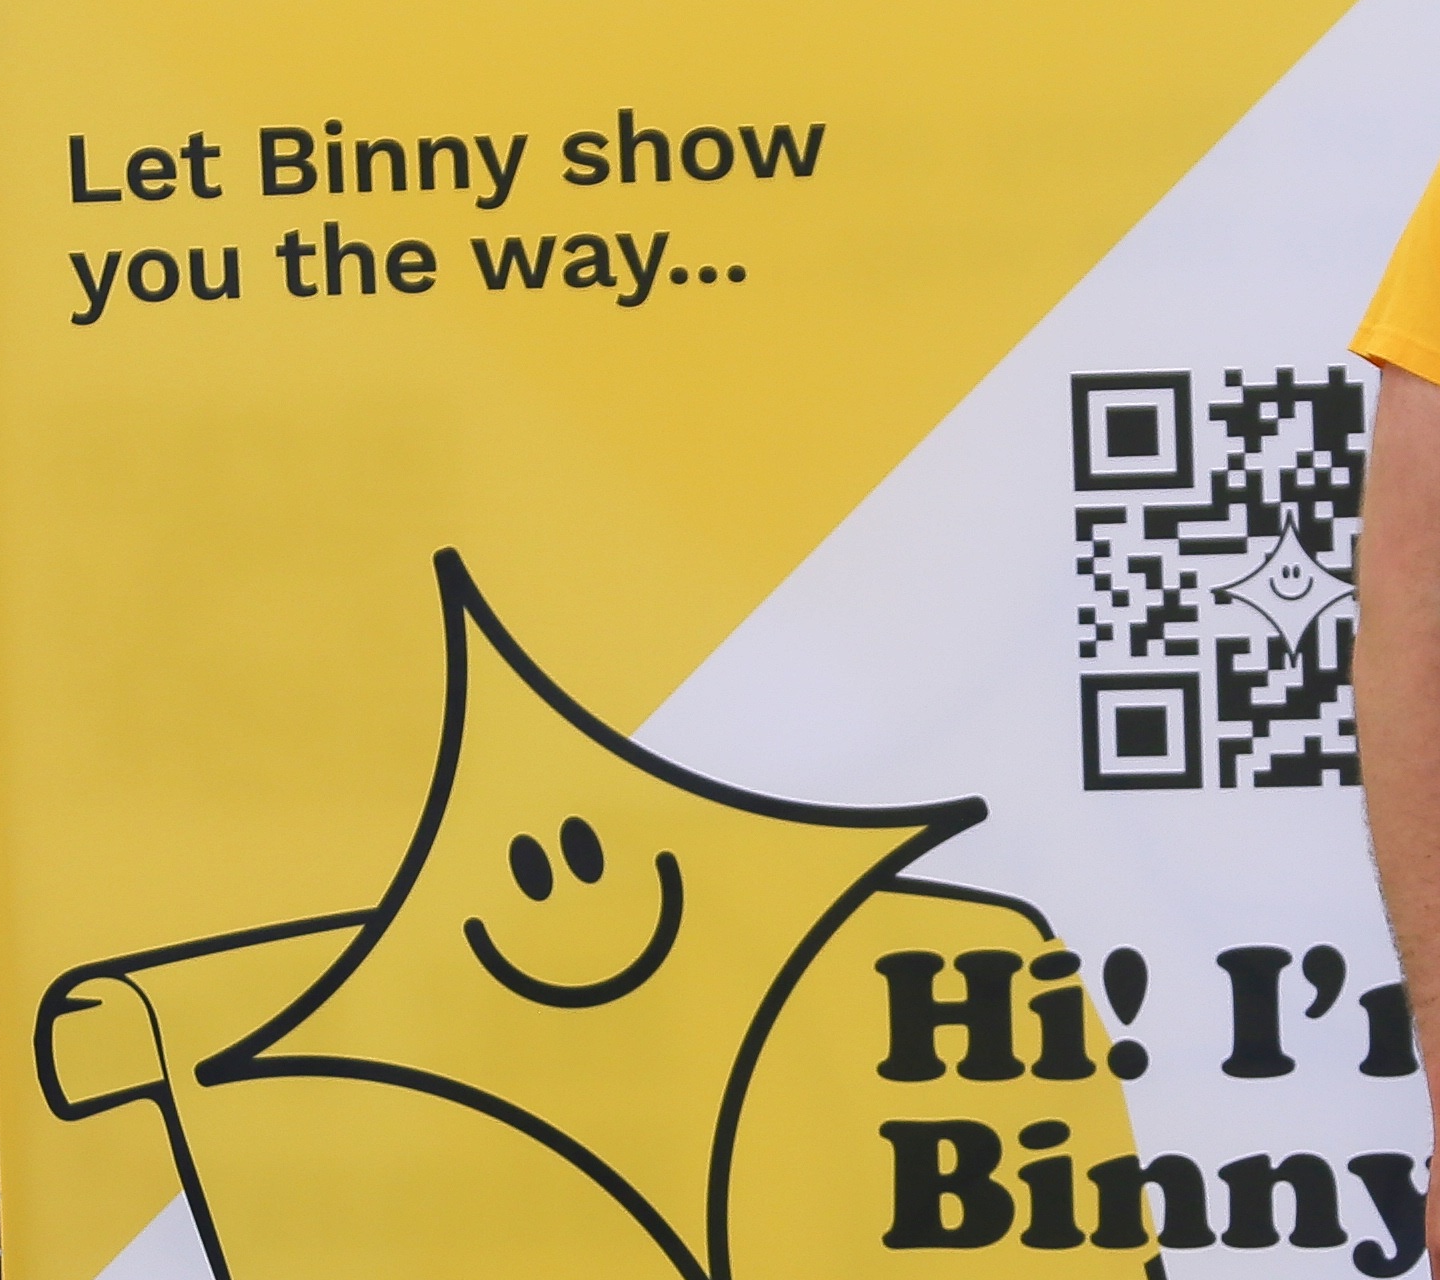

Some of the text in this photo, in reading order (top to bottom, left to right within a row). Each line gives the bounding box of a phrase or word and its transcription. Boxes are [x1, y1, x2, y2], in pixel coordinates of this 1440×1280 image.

[68, 108, 826, 210] Let Binny show
[68, 221, 747, 326] you the way...
[875, 945, 1149, 1082] Hi!
[878, 1119, 1429, 1280] Binny
